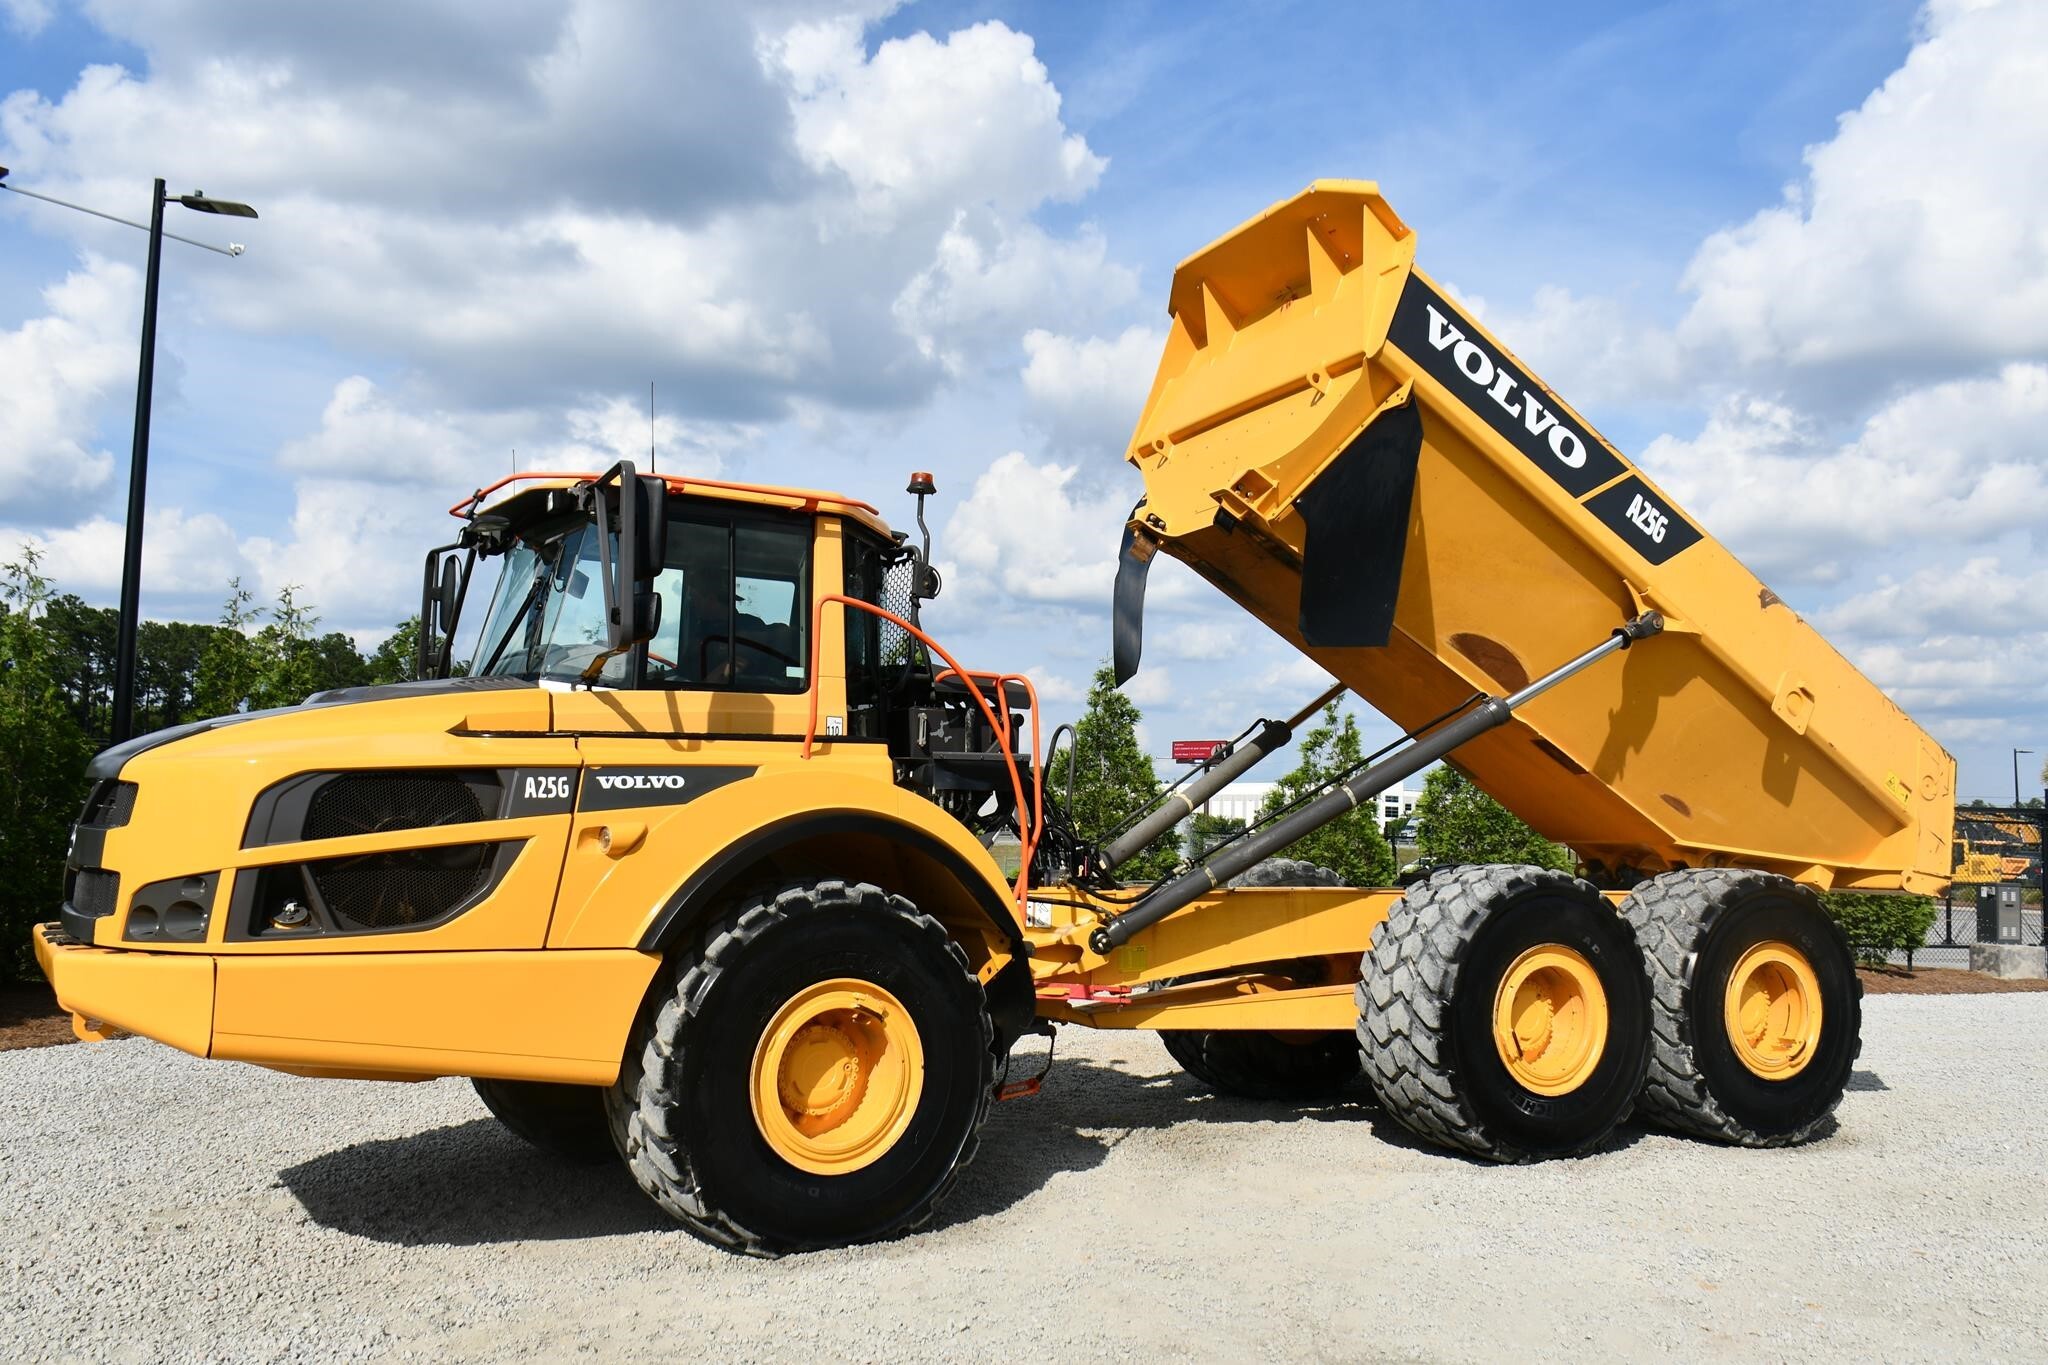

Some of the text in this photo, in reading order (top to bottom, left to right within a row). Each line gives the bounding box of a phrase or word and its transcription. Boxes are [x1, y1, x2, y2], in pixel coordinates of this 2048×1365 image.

[1426, 303, 1587, 469] VOLVO
[1625, 493, 1669, 544] A25G
[524, 776, 570, 799] A25G
[596, 775, 686, 790] VOLVO
